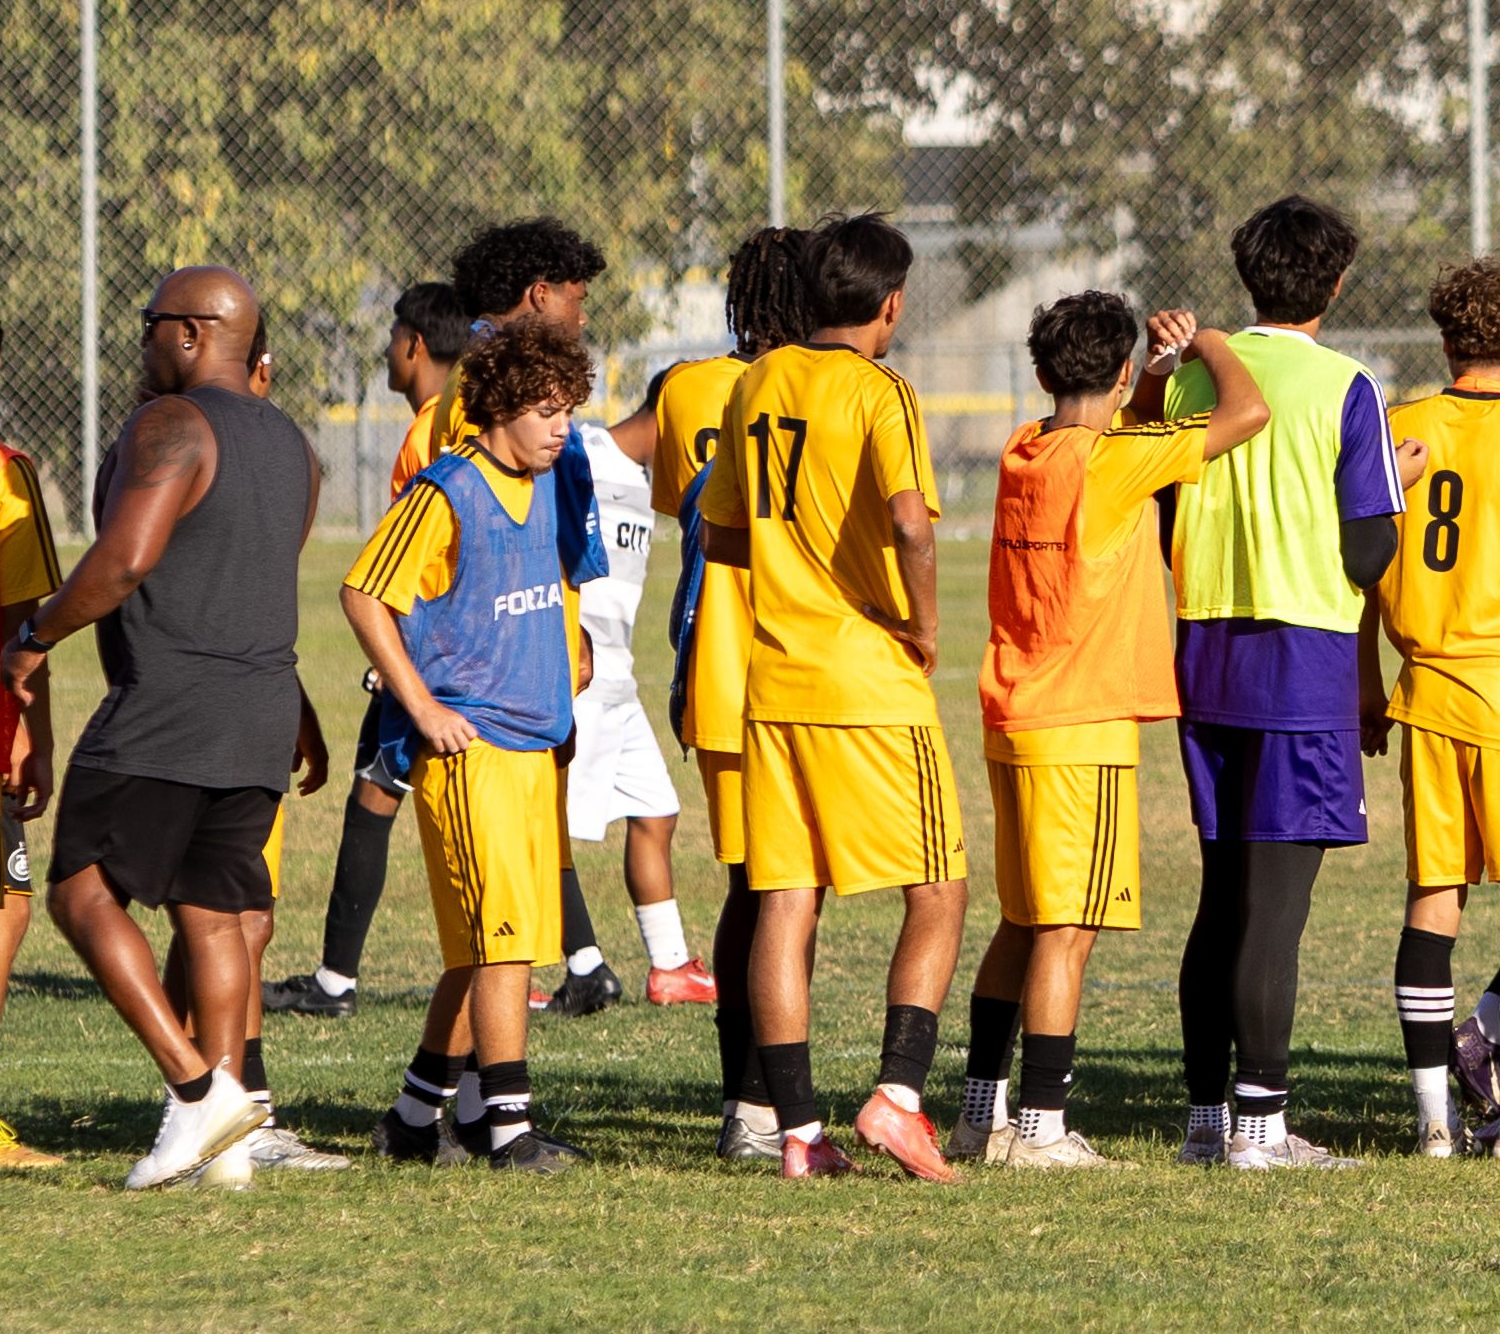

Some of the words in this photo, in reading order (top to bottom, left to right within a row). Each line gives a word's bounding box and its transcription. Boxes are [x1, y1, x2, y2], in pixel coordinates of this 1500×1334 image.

[747, 412, 808, 522] 17
[1423, 469, 1464, 573] 8
[493, 583, 564, 622] FORZA
